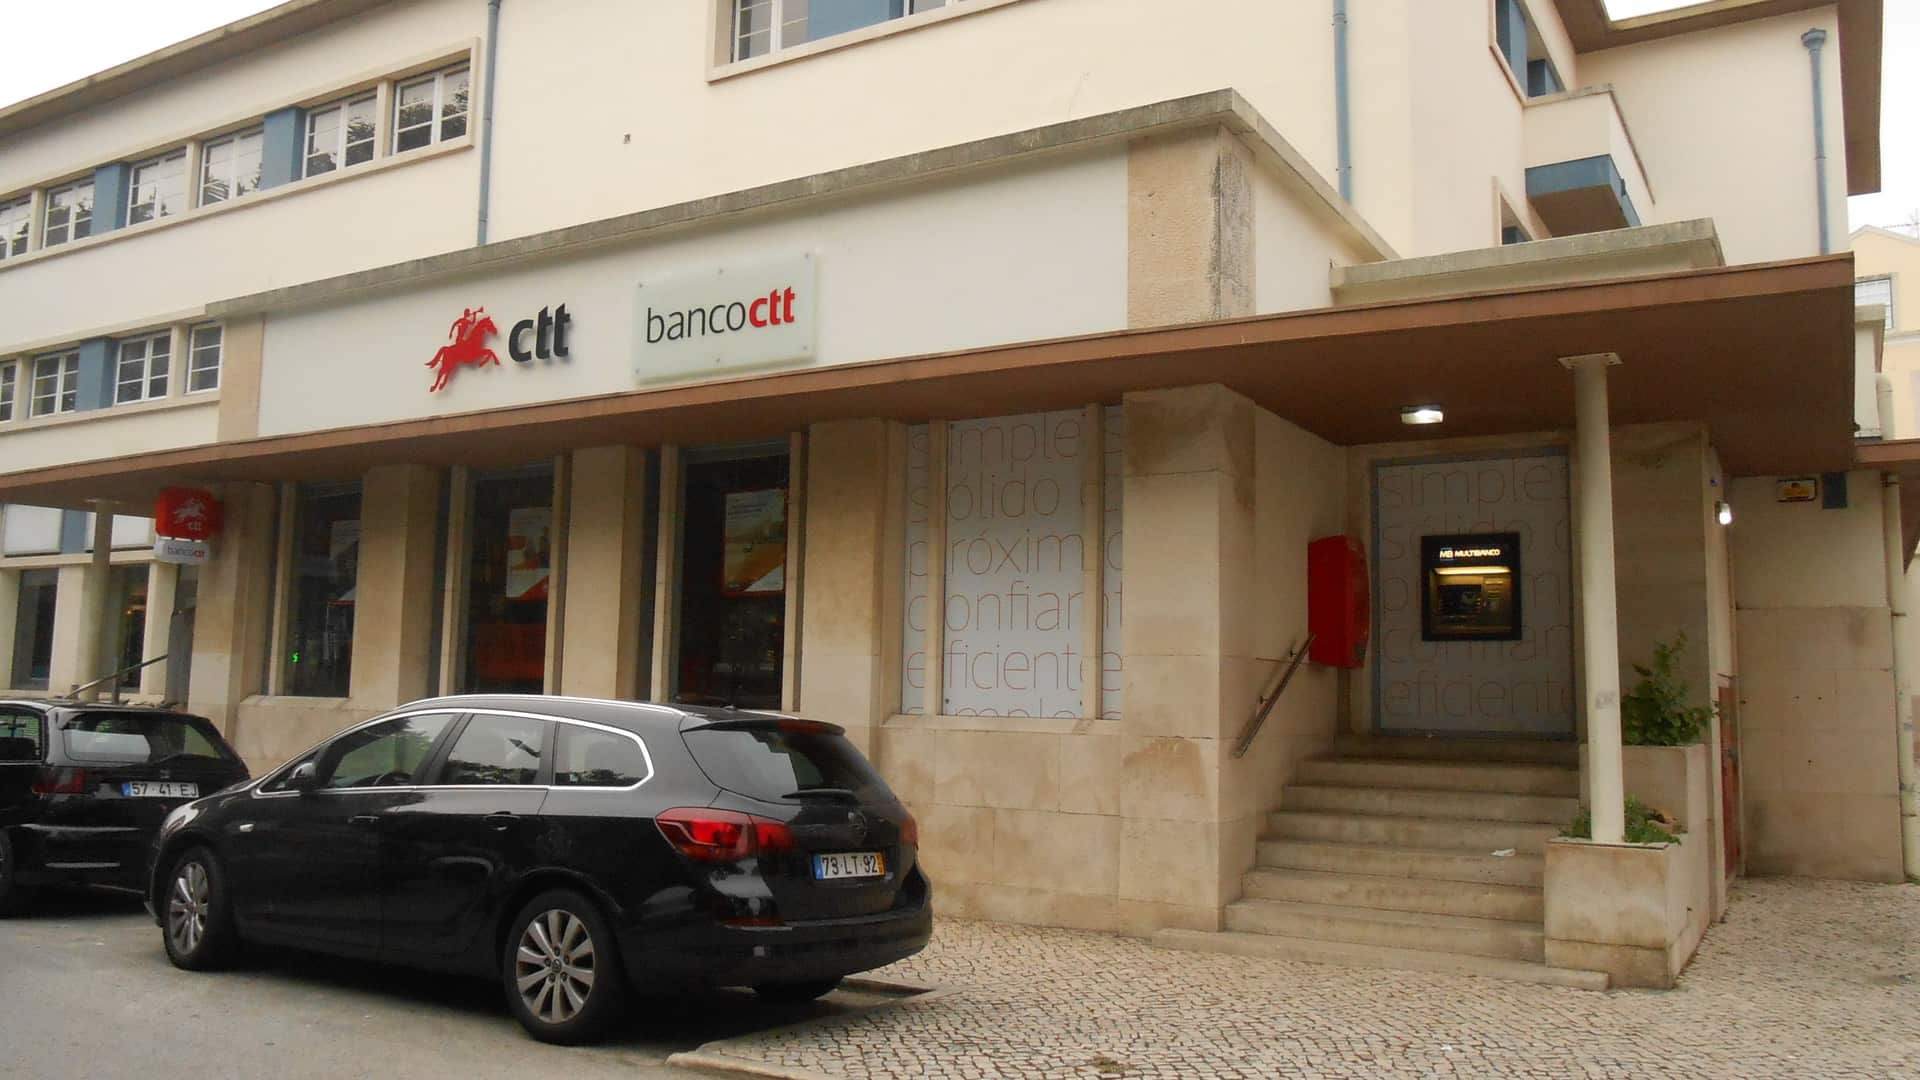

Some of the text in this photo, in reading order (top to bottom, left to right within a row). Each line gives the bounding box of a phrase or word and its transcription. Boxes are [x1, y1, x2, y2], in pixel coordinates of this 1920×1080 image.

[508, 303, 571, 362] ctt
[646, 286, 796, 344] bancoctt
[1454, 549, 1501, 558] MULTIBANCO
